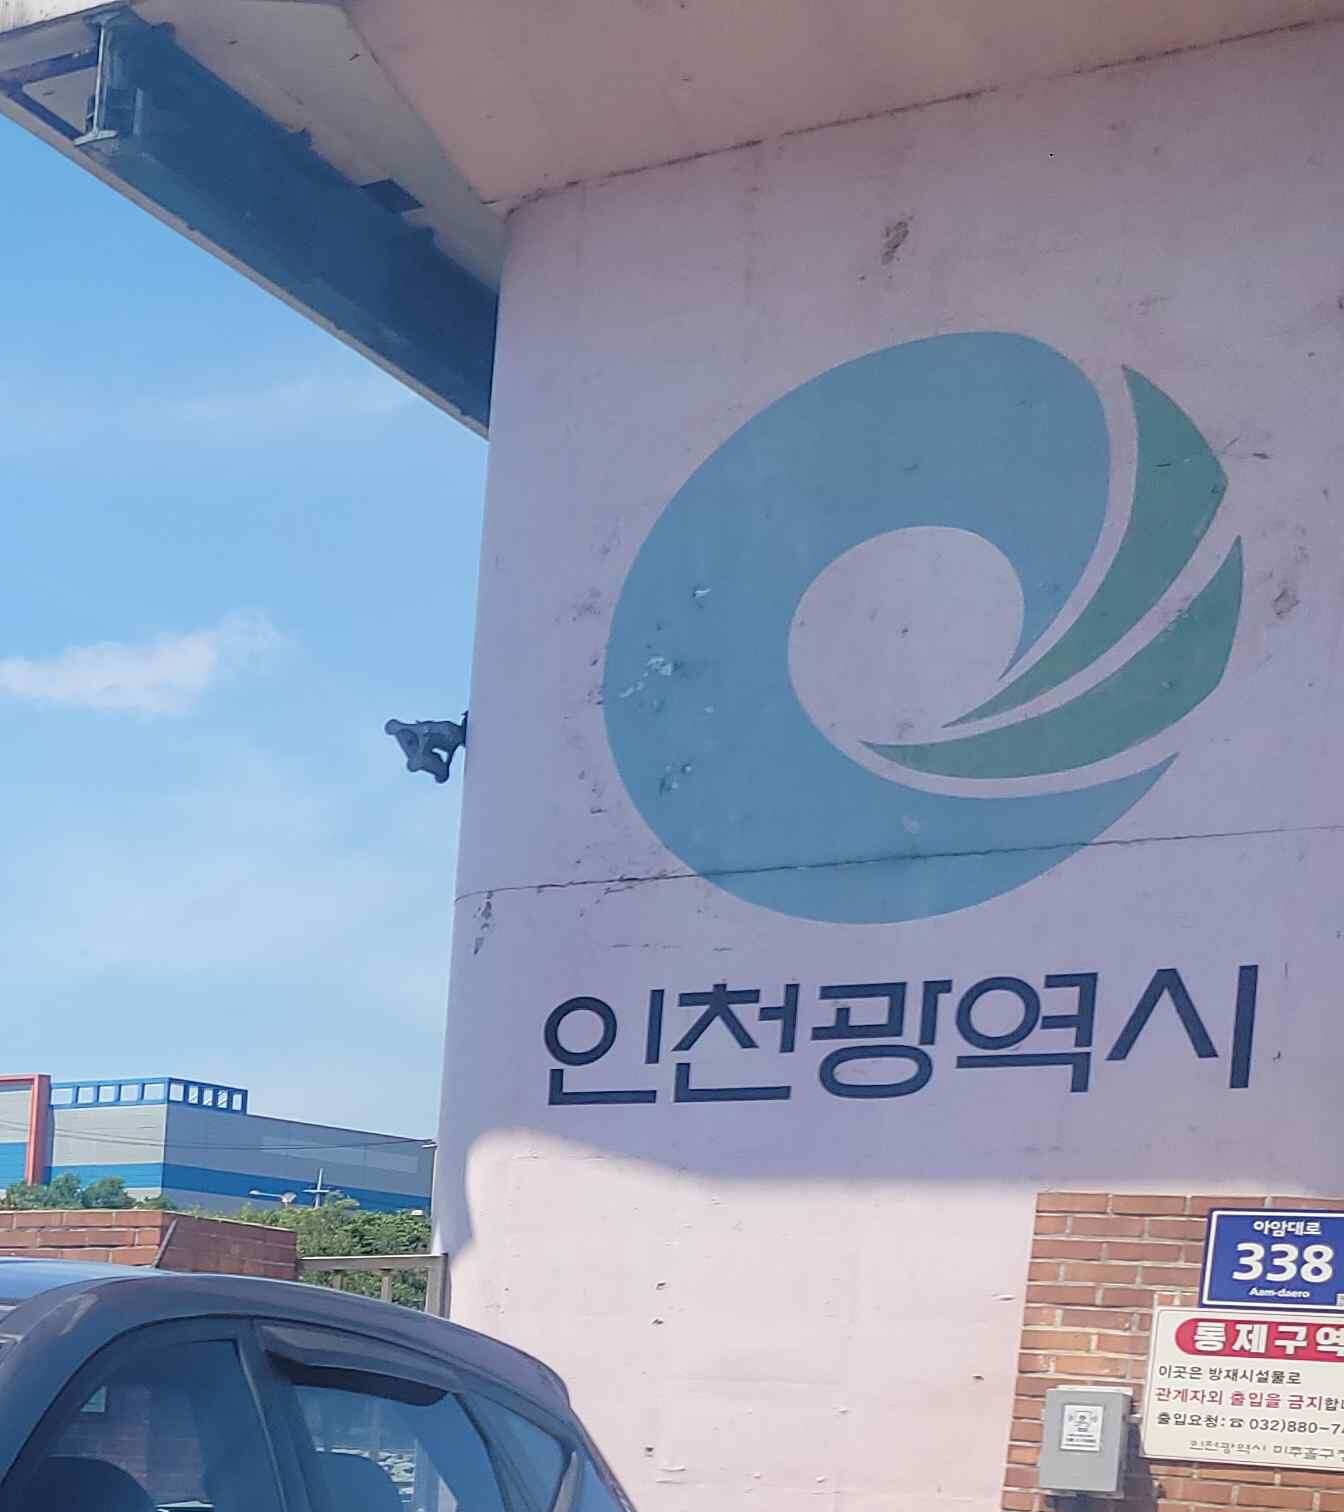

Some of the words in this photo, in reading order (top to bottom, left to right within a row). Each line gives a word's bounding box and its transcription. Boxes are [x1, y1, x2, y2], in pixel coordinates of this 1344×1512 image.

[543, 964, 1260, 1107] 인천광역시
[1253, 1220, 1323, 1238] 아암대로
[1232, 1242, 1335, 1284] 338
[1249, 1286, 1311, 1299] Aam-daero
[1158, 1365, 1203, 1381] 이곳은
[1209, 1367, 1302, 1385] 방재시설물로
[1155, 1387, 1224, 1406] 관계자외
[1230, 1390, 1282, 1409] 출입을
